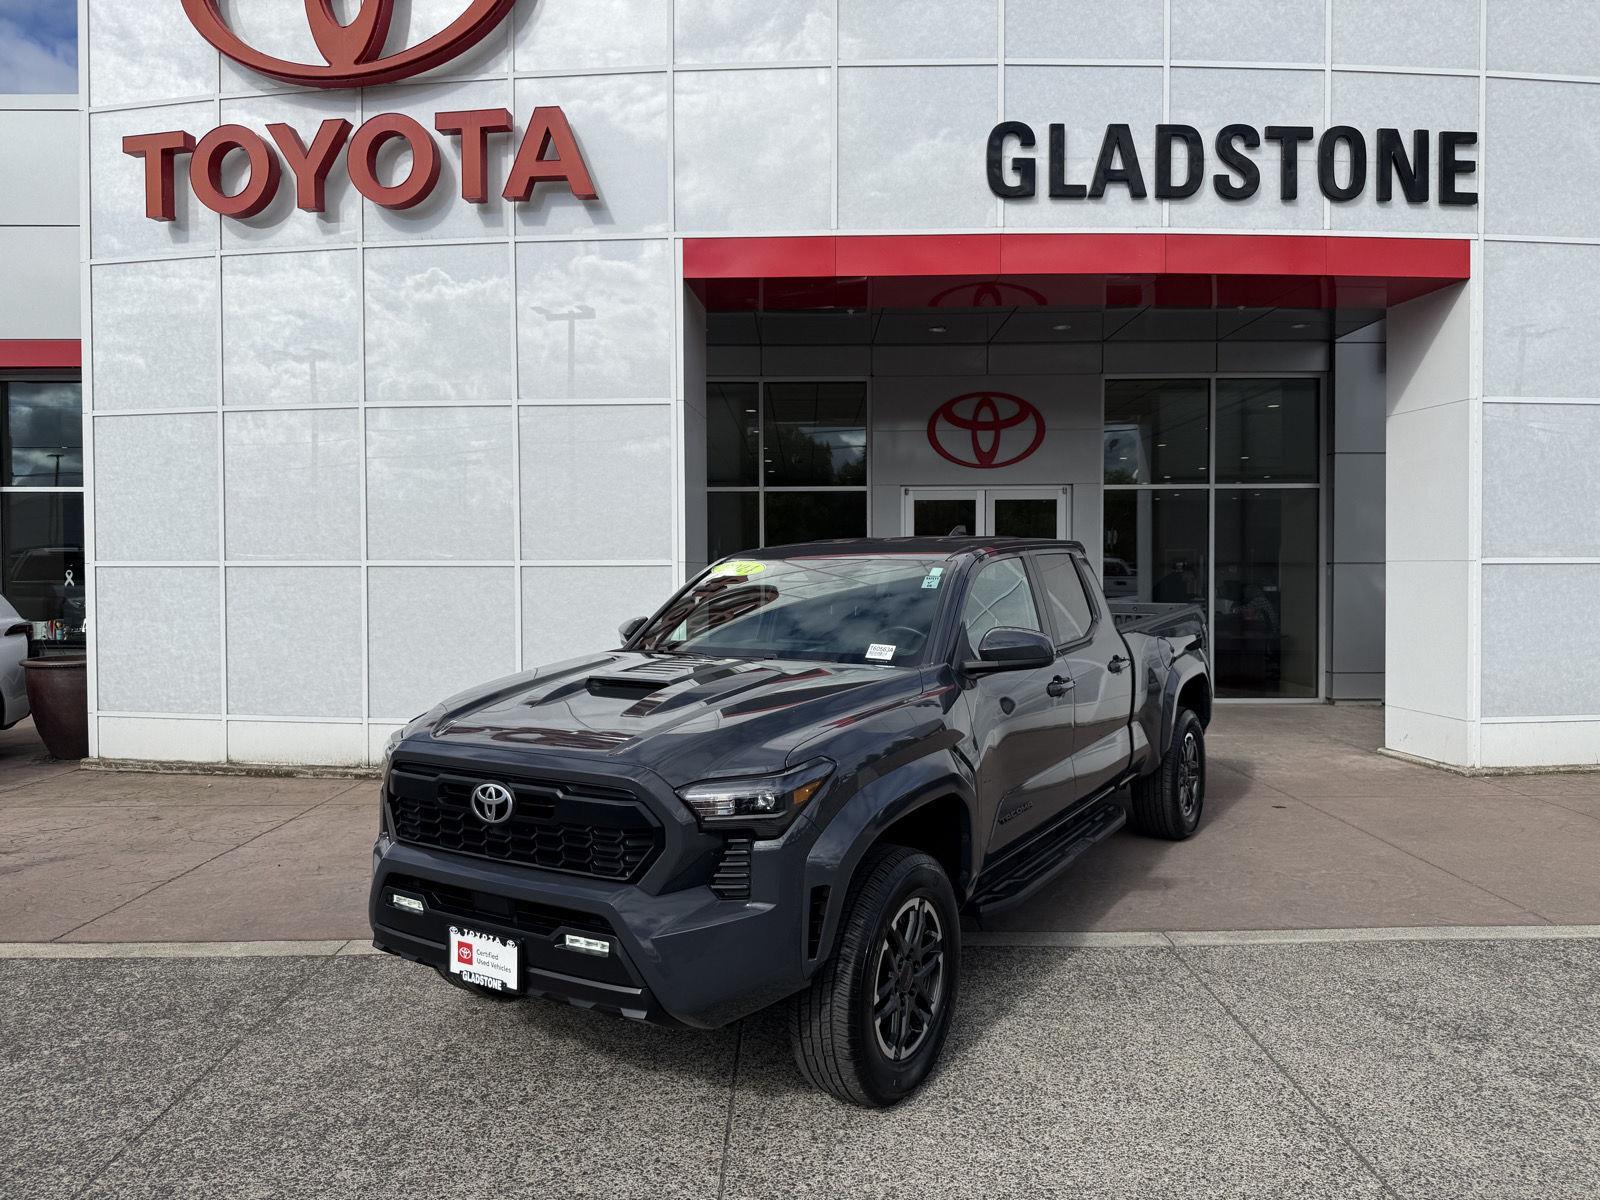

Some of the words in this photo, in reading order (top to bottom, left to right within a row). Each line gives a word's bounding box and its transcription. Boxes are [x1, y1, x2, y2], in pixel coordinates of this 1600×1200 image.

[122, 105, 599, 222] TOYOTA
[986, 120, 1479, 206] GLADSTONE
[998, 800, 1033, 825] TACOMA
[463, 928, 501, 944] TOYOTA
[476, 948, 499, 961] Certified
[476, 957, 490, 967] Used
[490, 961, 512, 974] Vehicles
[462, 969, 503, 991] GLADSTONE
